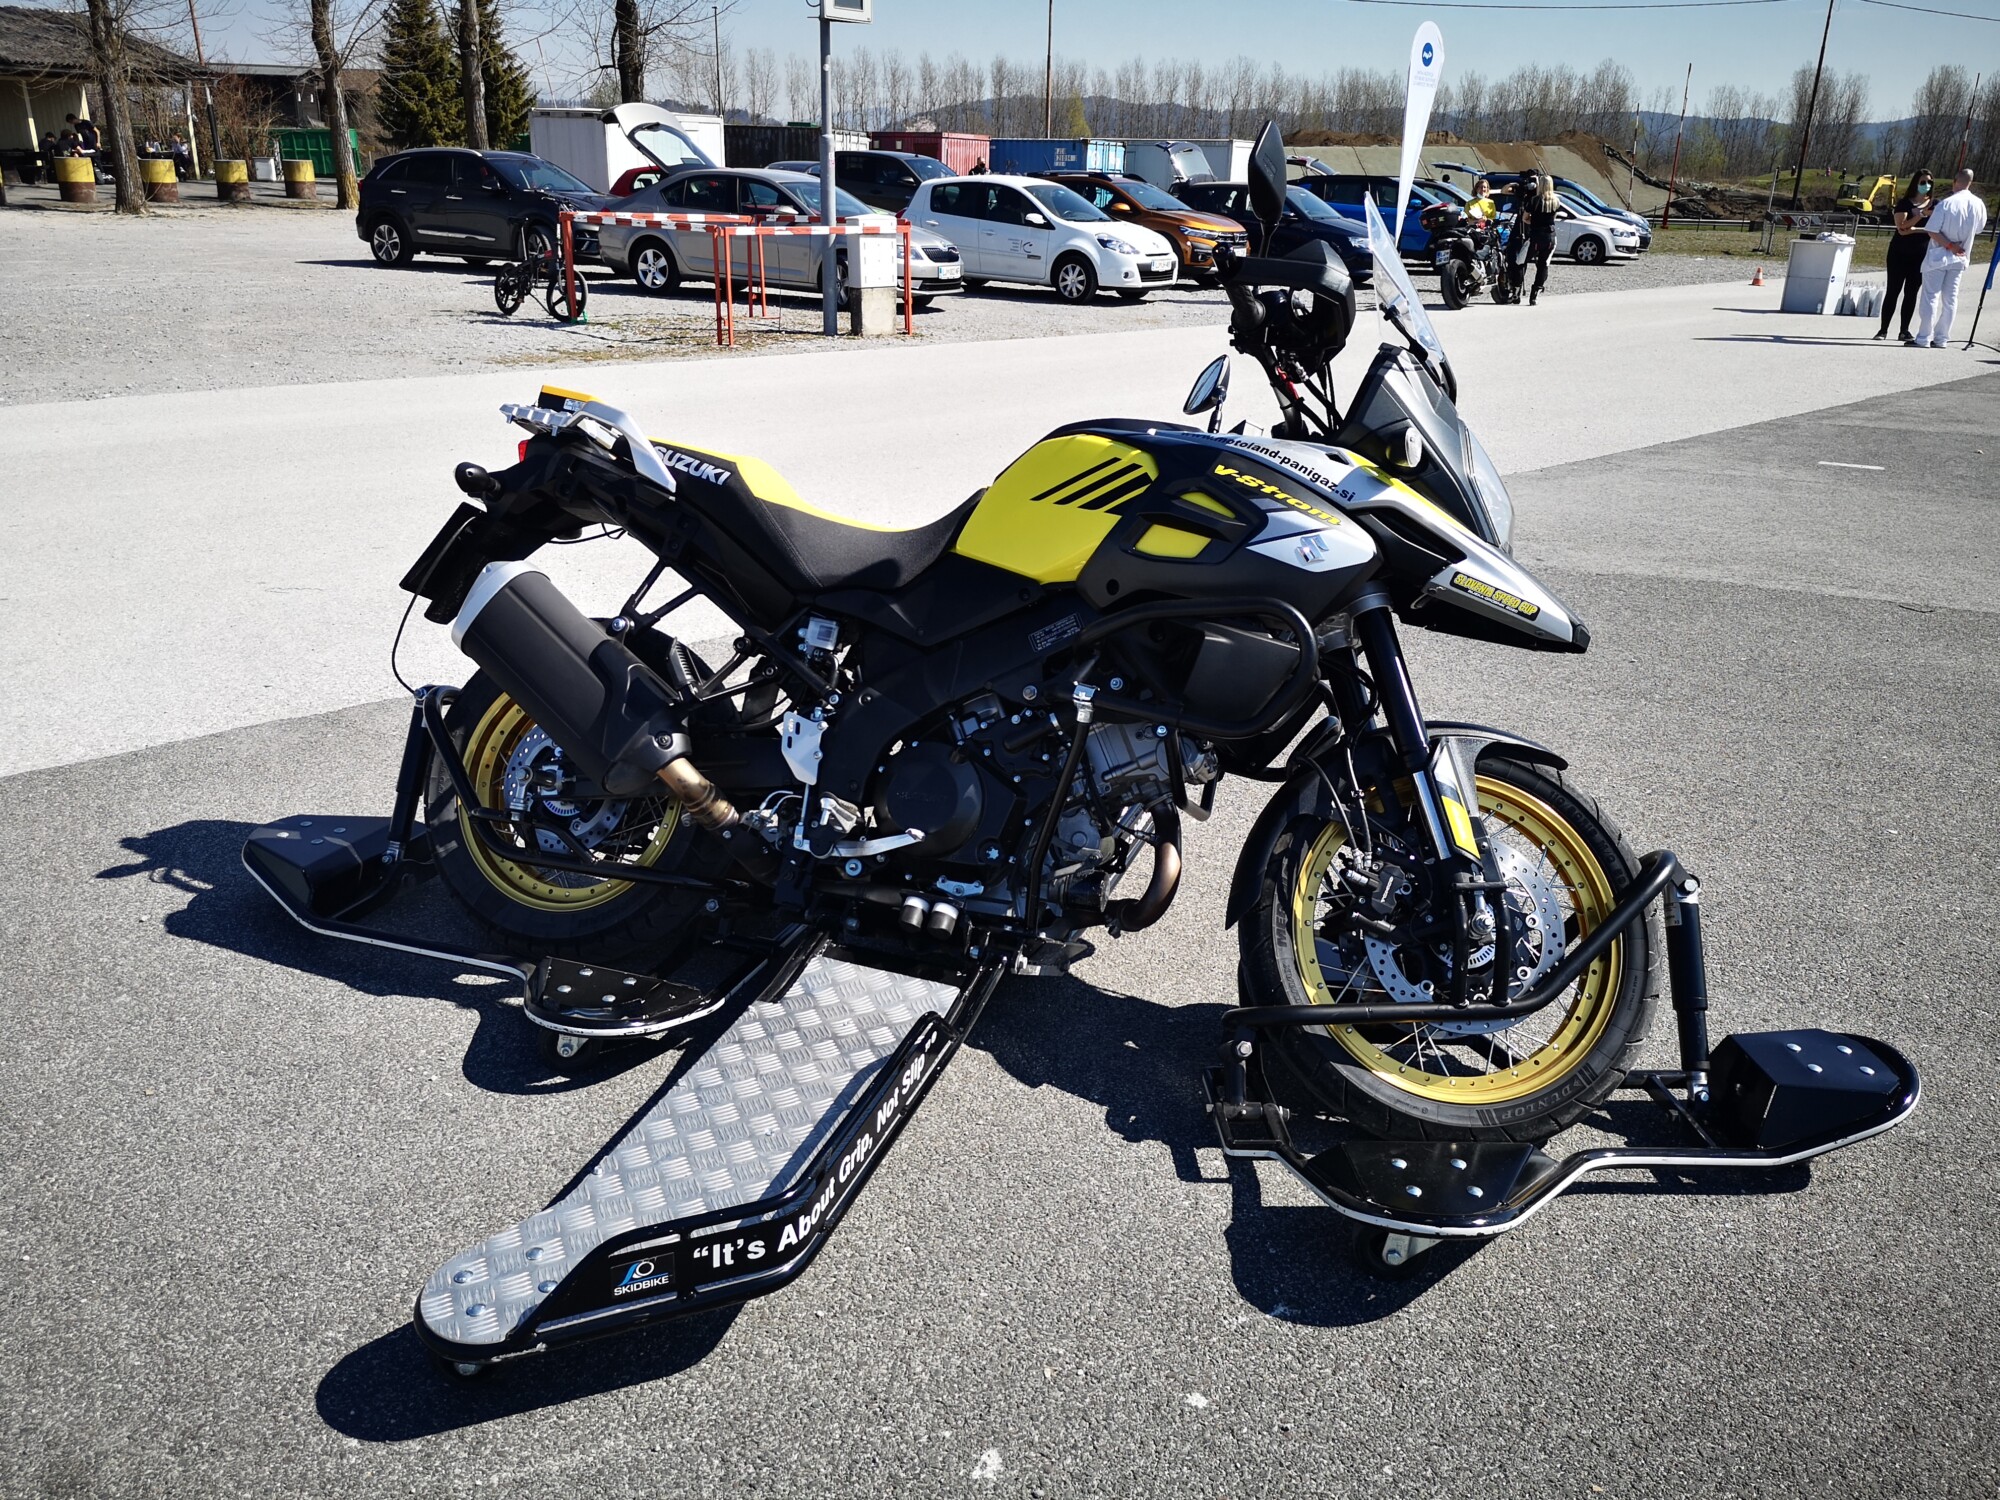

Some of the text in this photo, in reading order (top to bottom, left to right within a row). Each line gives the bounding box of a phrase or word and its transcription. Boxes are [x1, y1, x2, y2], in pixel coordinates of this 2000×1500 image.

[653, 445, 732, 486] SUZUKI
[1181, 432, 1357, 502] www.motoland-panigaz.si
[1453, 573, 1538, 616] SLOVENIA SPEED CUP
[1501, 1084, 1572, 1120] DUNLOP
[777, 1176, 836, 1253] About
[838, 1132, 874, 1184] Grip,
[876, 1086, 900, 1133] Not
[613, 1275, 670, 1297] SKIDBIKE
